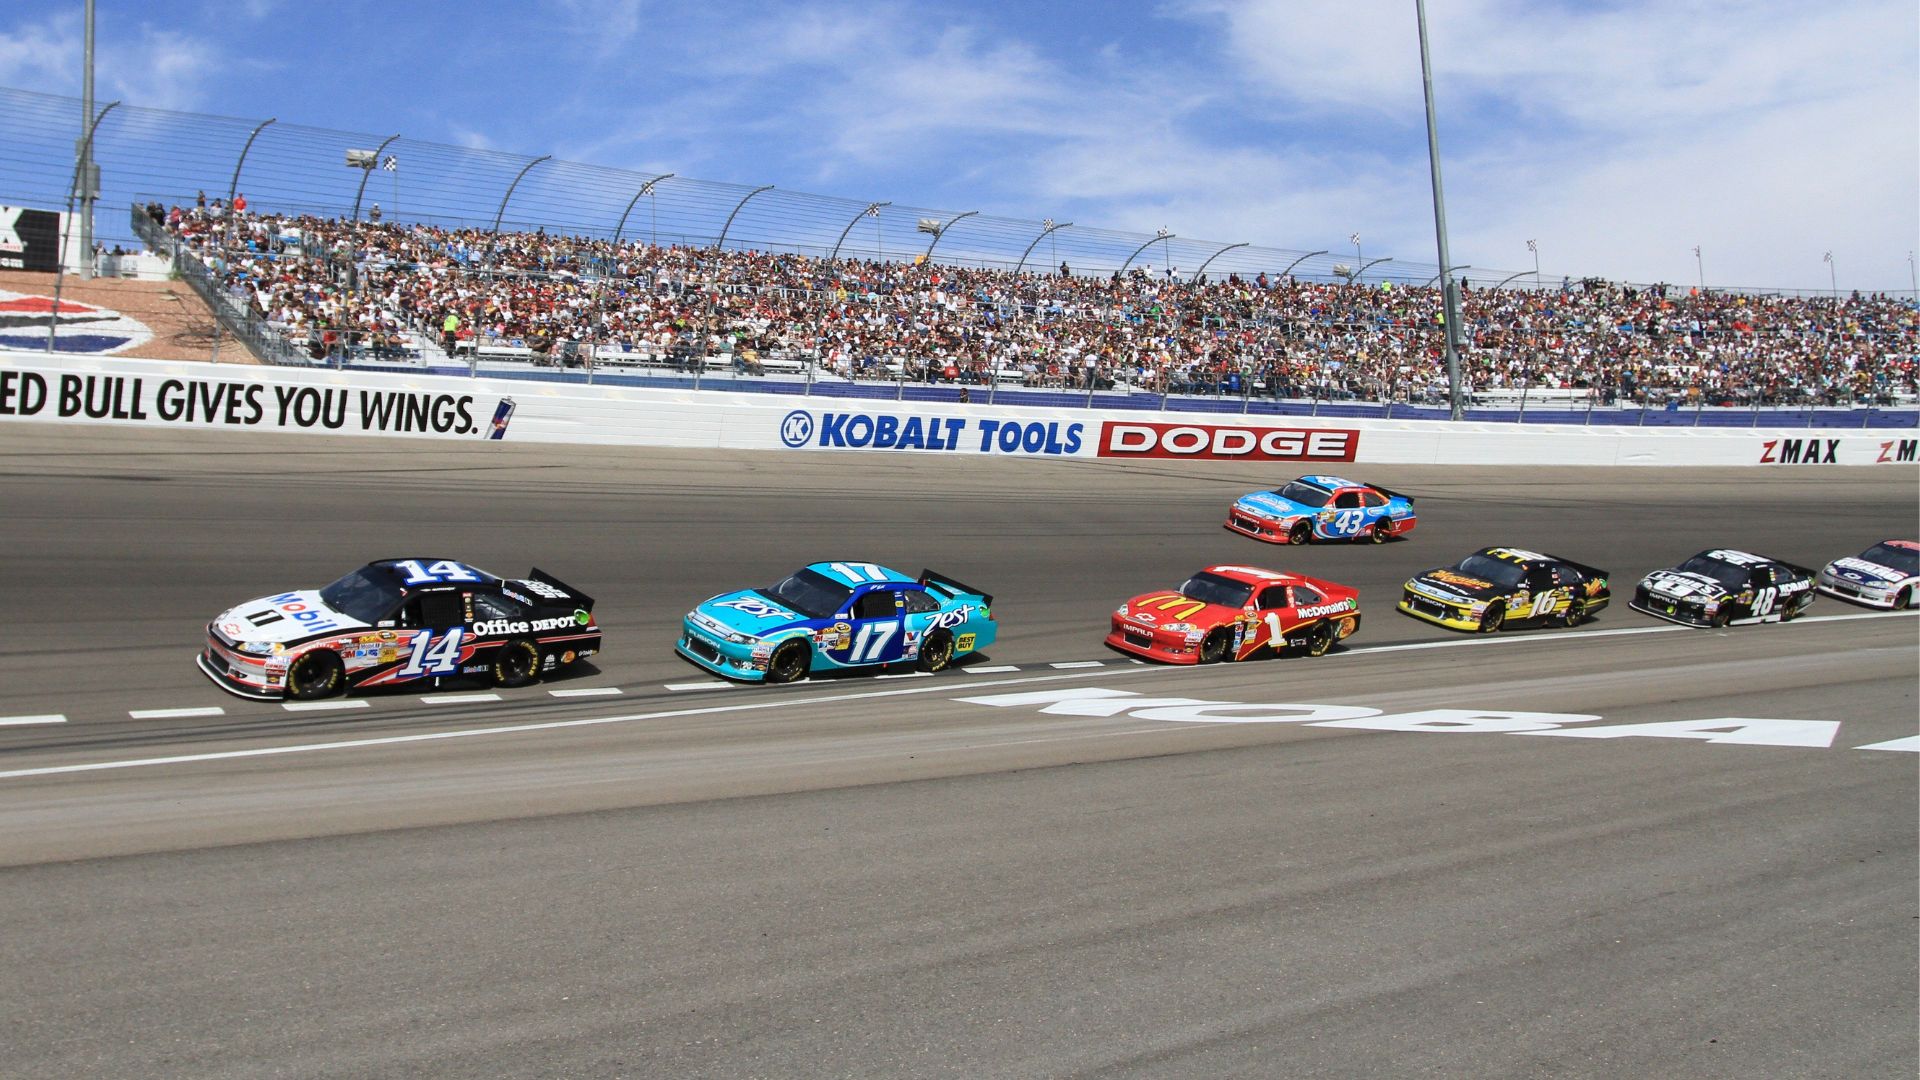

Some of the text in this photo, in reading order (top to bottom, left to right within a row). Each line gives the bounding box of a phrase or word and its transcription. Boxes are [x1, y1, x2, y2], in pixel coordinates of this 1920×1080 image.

[0, 371, 478, 435] ED BULL GIVES YOU WINGS.
[819, 413, 965, 450] KOBALT
[979, 420, 1084, 454] TOOLS
[1110, 425, 1349, 457] DODGE
[1876, 439, 1919, 463] ZM
[1335, 510, 1364, 534] 43
[396, 560, 480, 585] 14
[829, 562, 889, 583] 17
[1778, 579, 1811, 595] KOBALT
[269, 593, 338, 632] Mobil
[1297, 601, 1349, 619] McDonald's
[1413, 594, 1446, 609] FUSION
[1527, 588, 1558, 619] 16
[1750, 586, 1777, 617] 48
[473, 616, 577, 636] Office DEPOT
[1123, 623, 1153, 638] IMPALA
[1264, 612, 1288, 648] 1
[688, 629, 721, 649] FUSION
[849, 621, 900, 664] 17
[398, 627, 465, 677] 14
